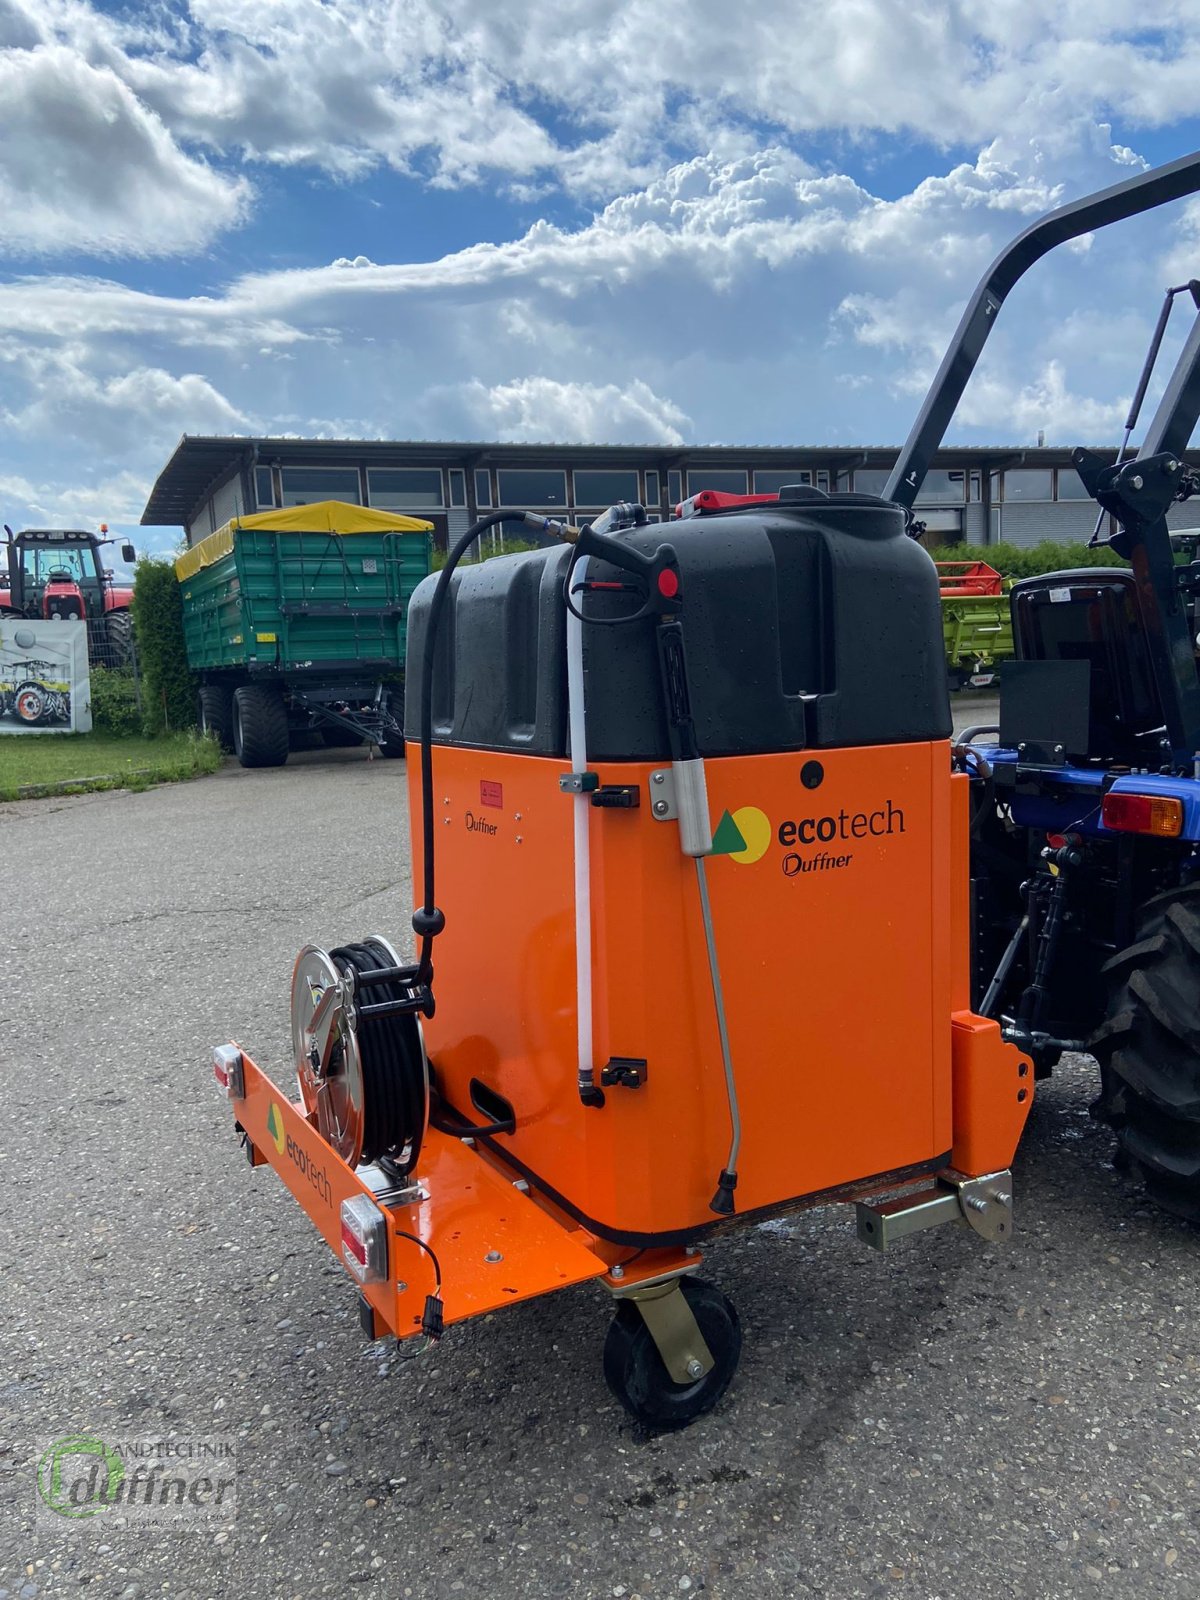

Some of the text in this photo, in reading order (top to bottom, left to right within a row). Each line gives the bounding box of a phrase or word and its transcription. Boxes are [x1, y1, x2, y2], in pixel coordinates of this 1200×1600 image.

[465, 811, 498, 836] Duffner
[778, 800, 905, 846] ecotech
[782, 852, 853, 877] Duffner
[286, 1133, 333, 1209] ecotech
